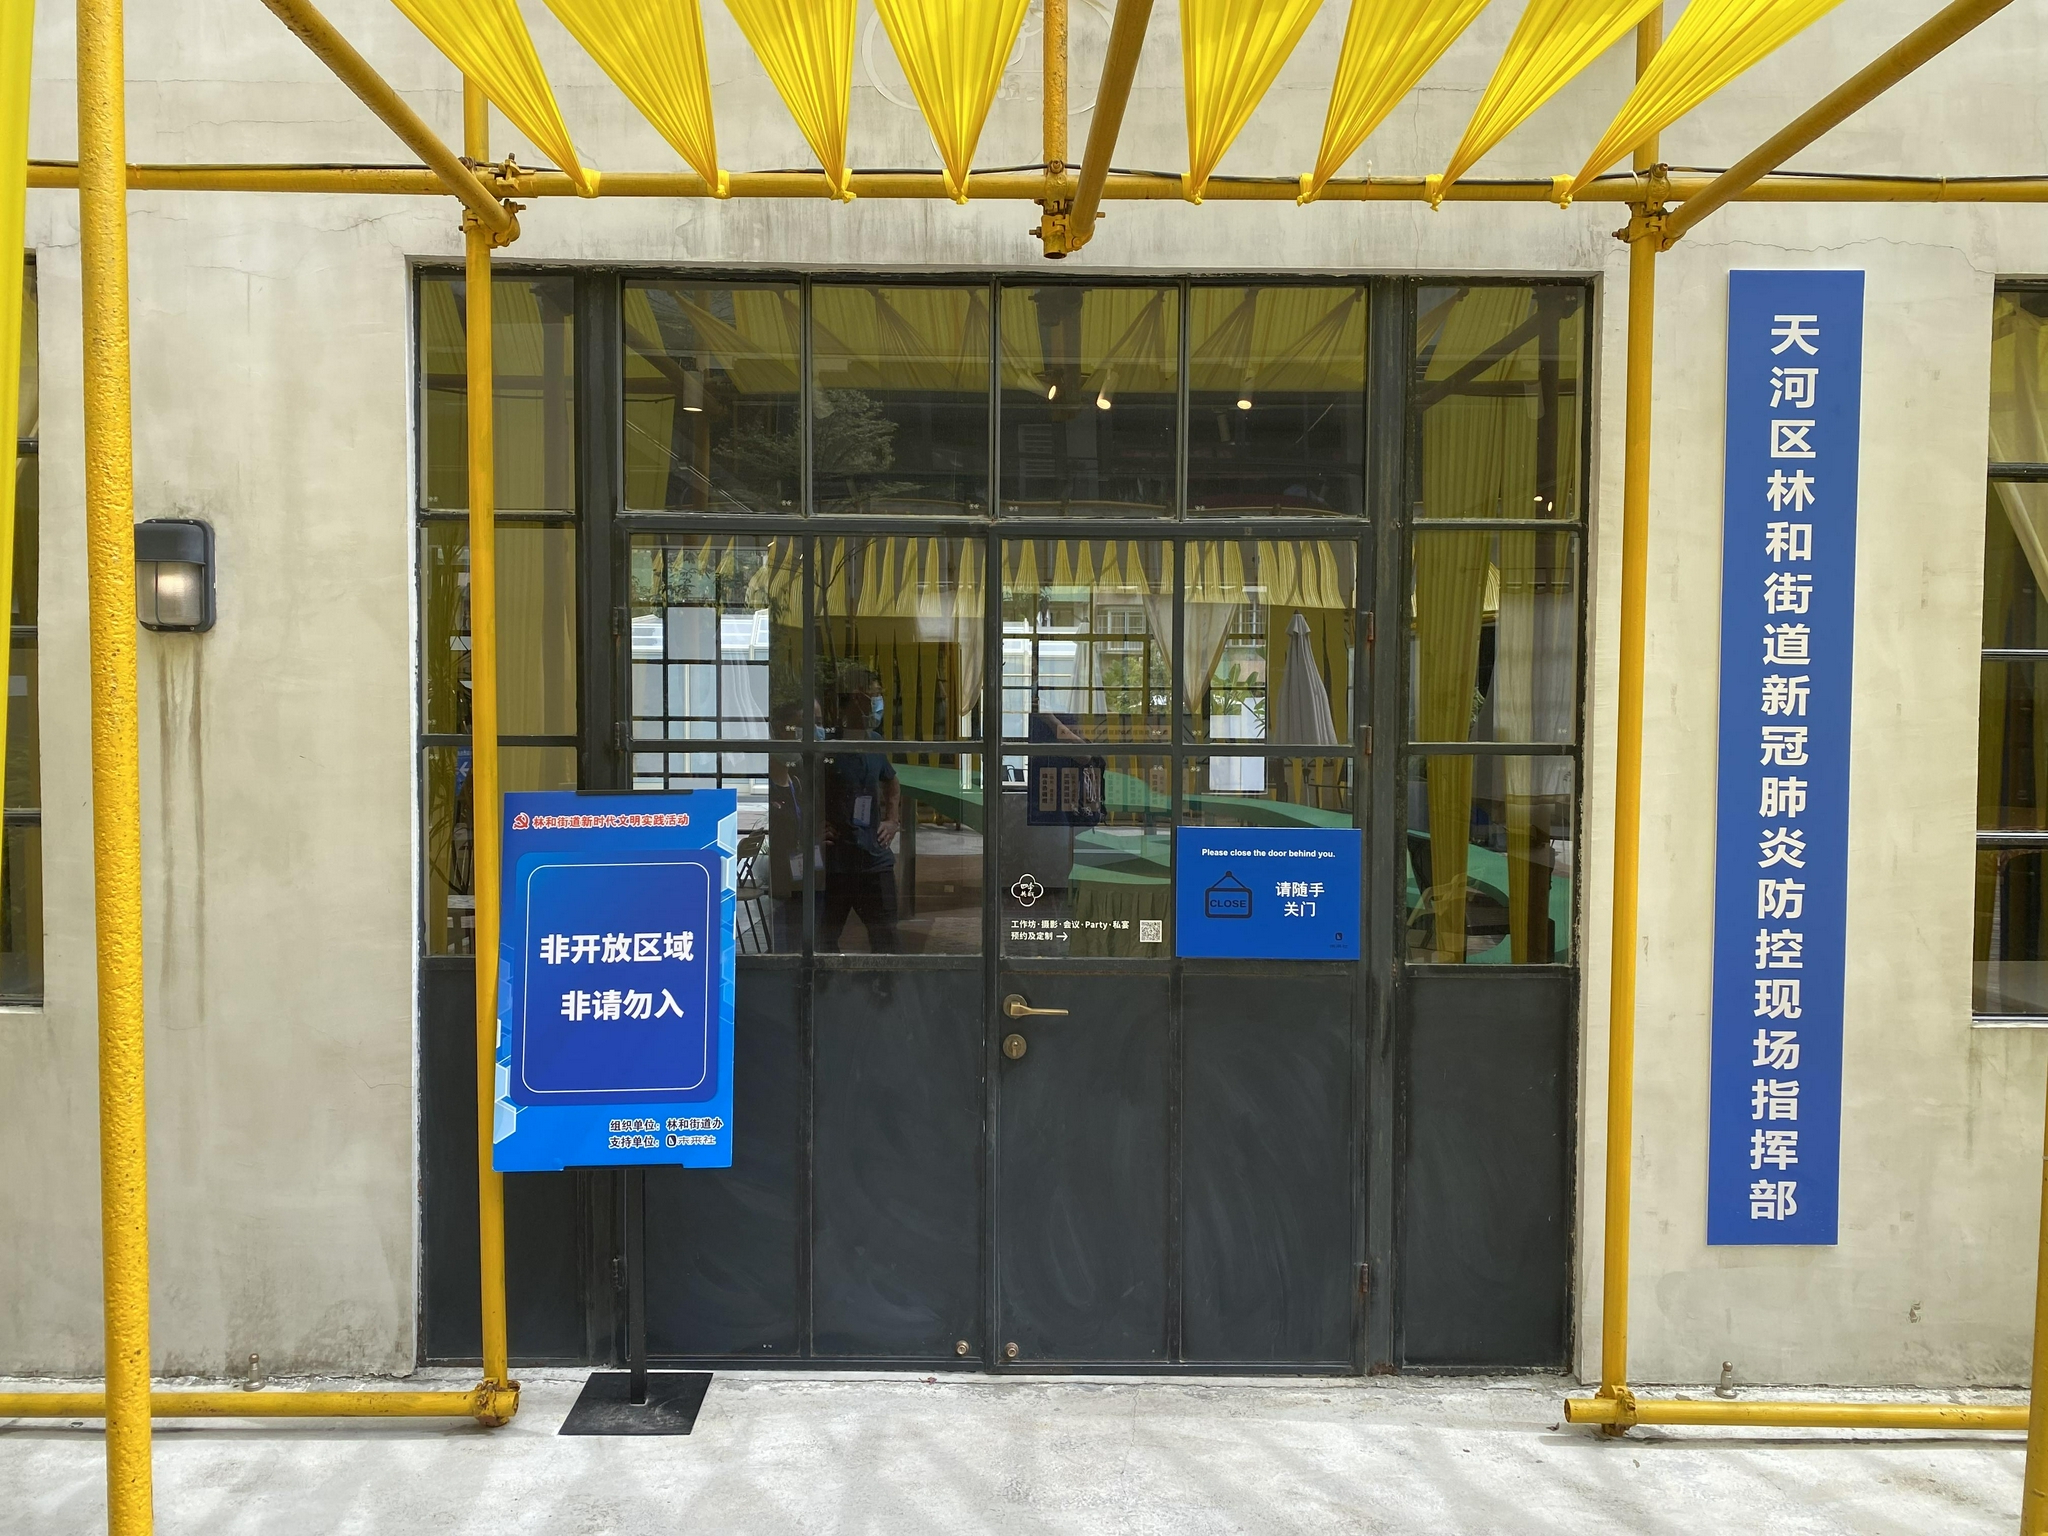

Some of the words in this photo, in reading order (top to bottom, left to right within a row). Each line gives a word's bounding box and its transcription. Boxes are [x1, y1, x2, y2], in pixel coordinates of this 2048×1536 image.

[1748, 313, 1820, 1222] 天河区林和街道新冠肺炎防控现场指挥部
[532, 813, 690, 829] 林和街道新时代文明实践活动
[1201, 848, 1228, 857] Please
[1230, 849, 1252, 857] close
[1253, 849, 1266, 857] the
[1268, 849, 1287, 858] door
[1288, 849, 1316, 858] behind
[1318, 850, 1336, 859] you.
[1275, 881, 1325, 898] 请随手
[1209, 899, 1247, 908] CLOSE
[1284, 901, 1316, 917] 关门
[1011, 931, 1054, 941] 预约及定制
[540, 931, 694, 965] 非开放区域
[561, 989, 685, 1022] 非请勿入
